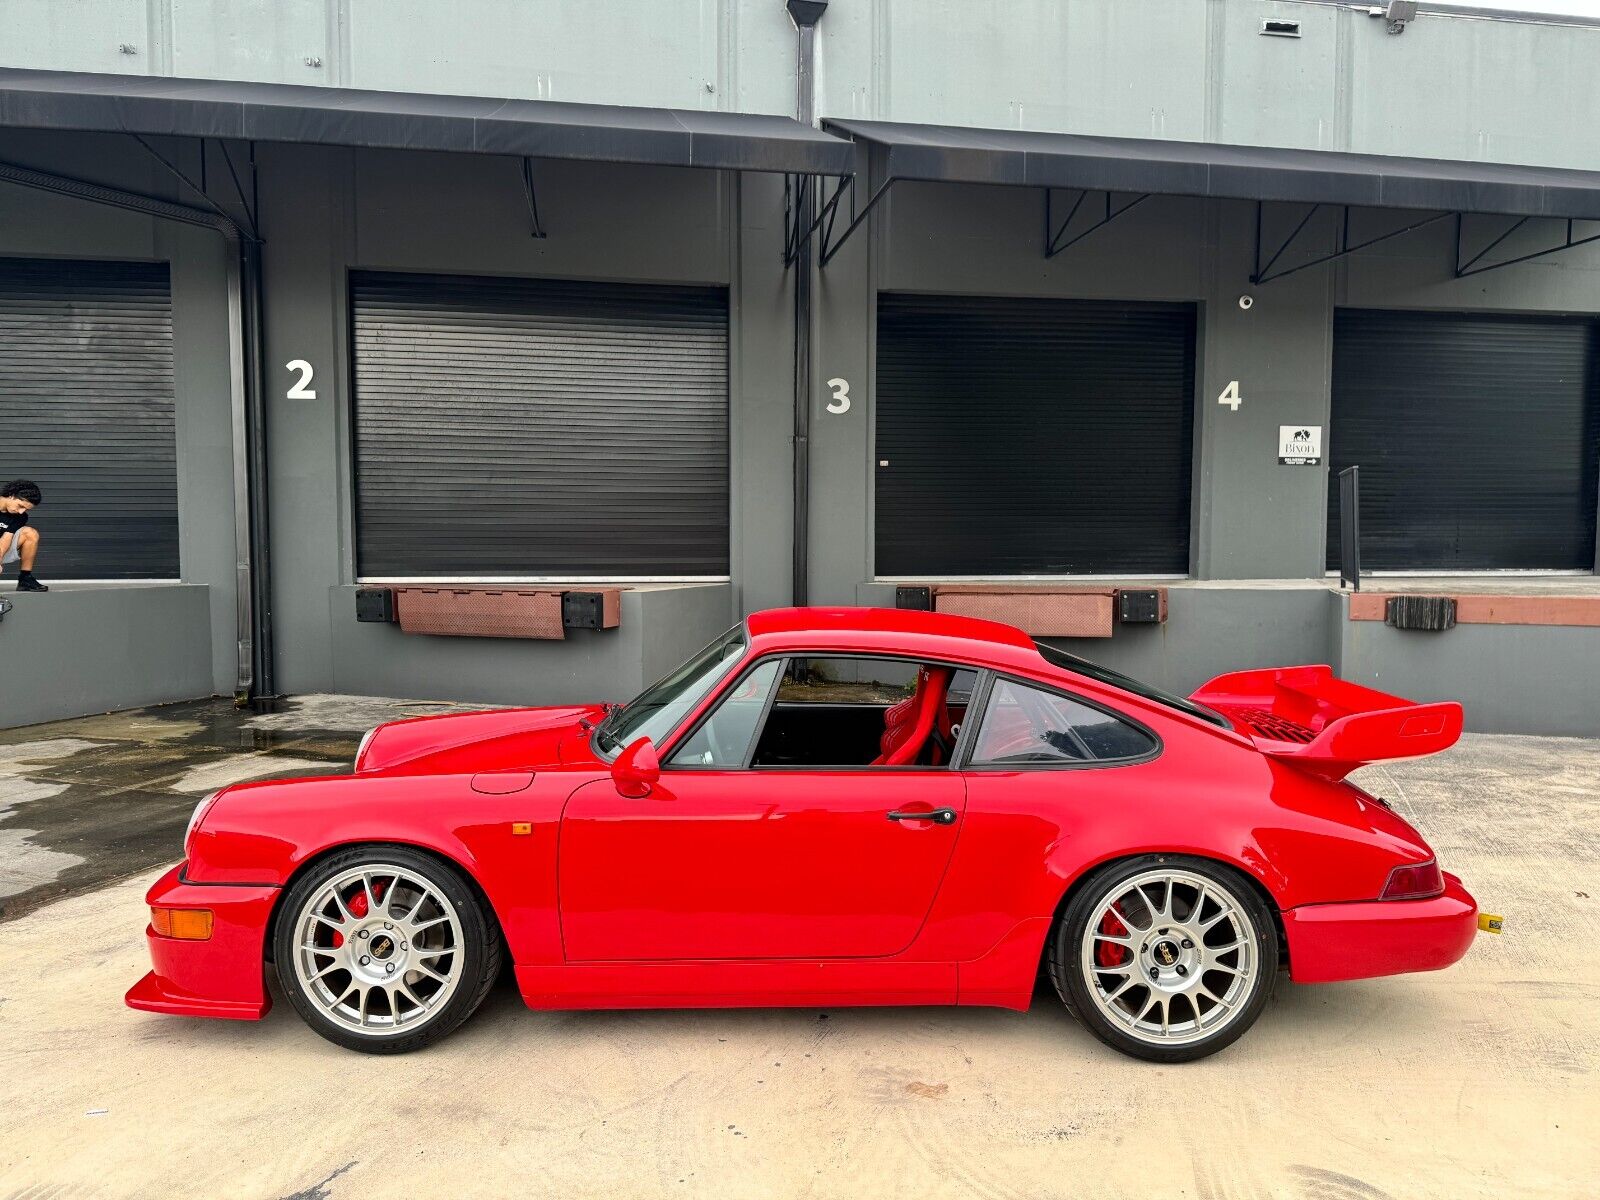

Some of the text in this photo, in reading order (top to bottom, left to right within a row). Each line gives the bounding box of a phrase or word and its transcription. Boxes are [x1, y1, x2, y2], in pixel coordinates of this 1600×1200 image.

[285, 359, 317, 400] 2
[826, 377, 851, 414] 3
[1218, 380, 1242, 411] 4
[373, 938, 391, 957] BBS
